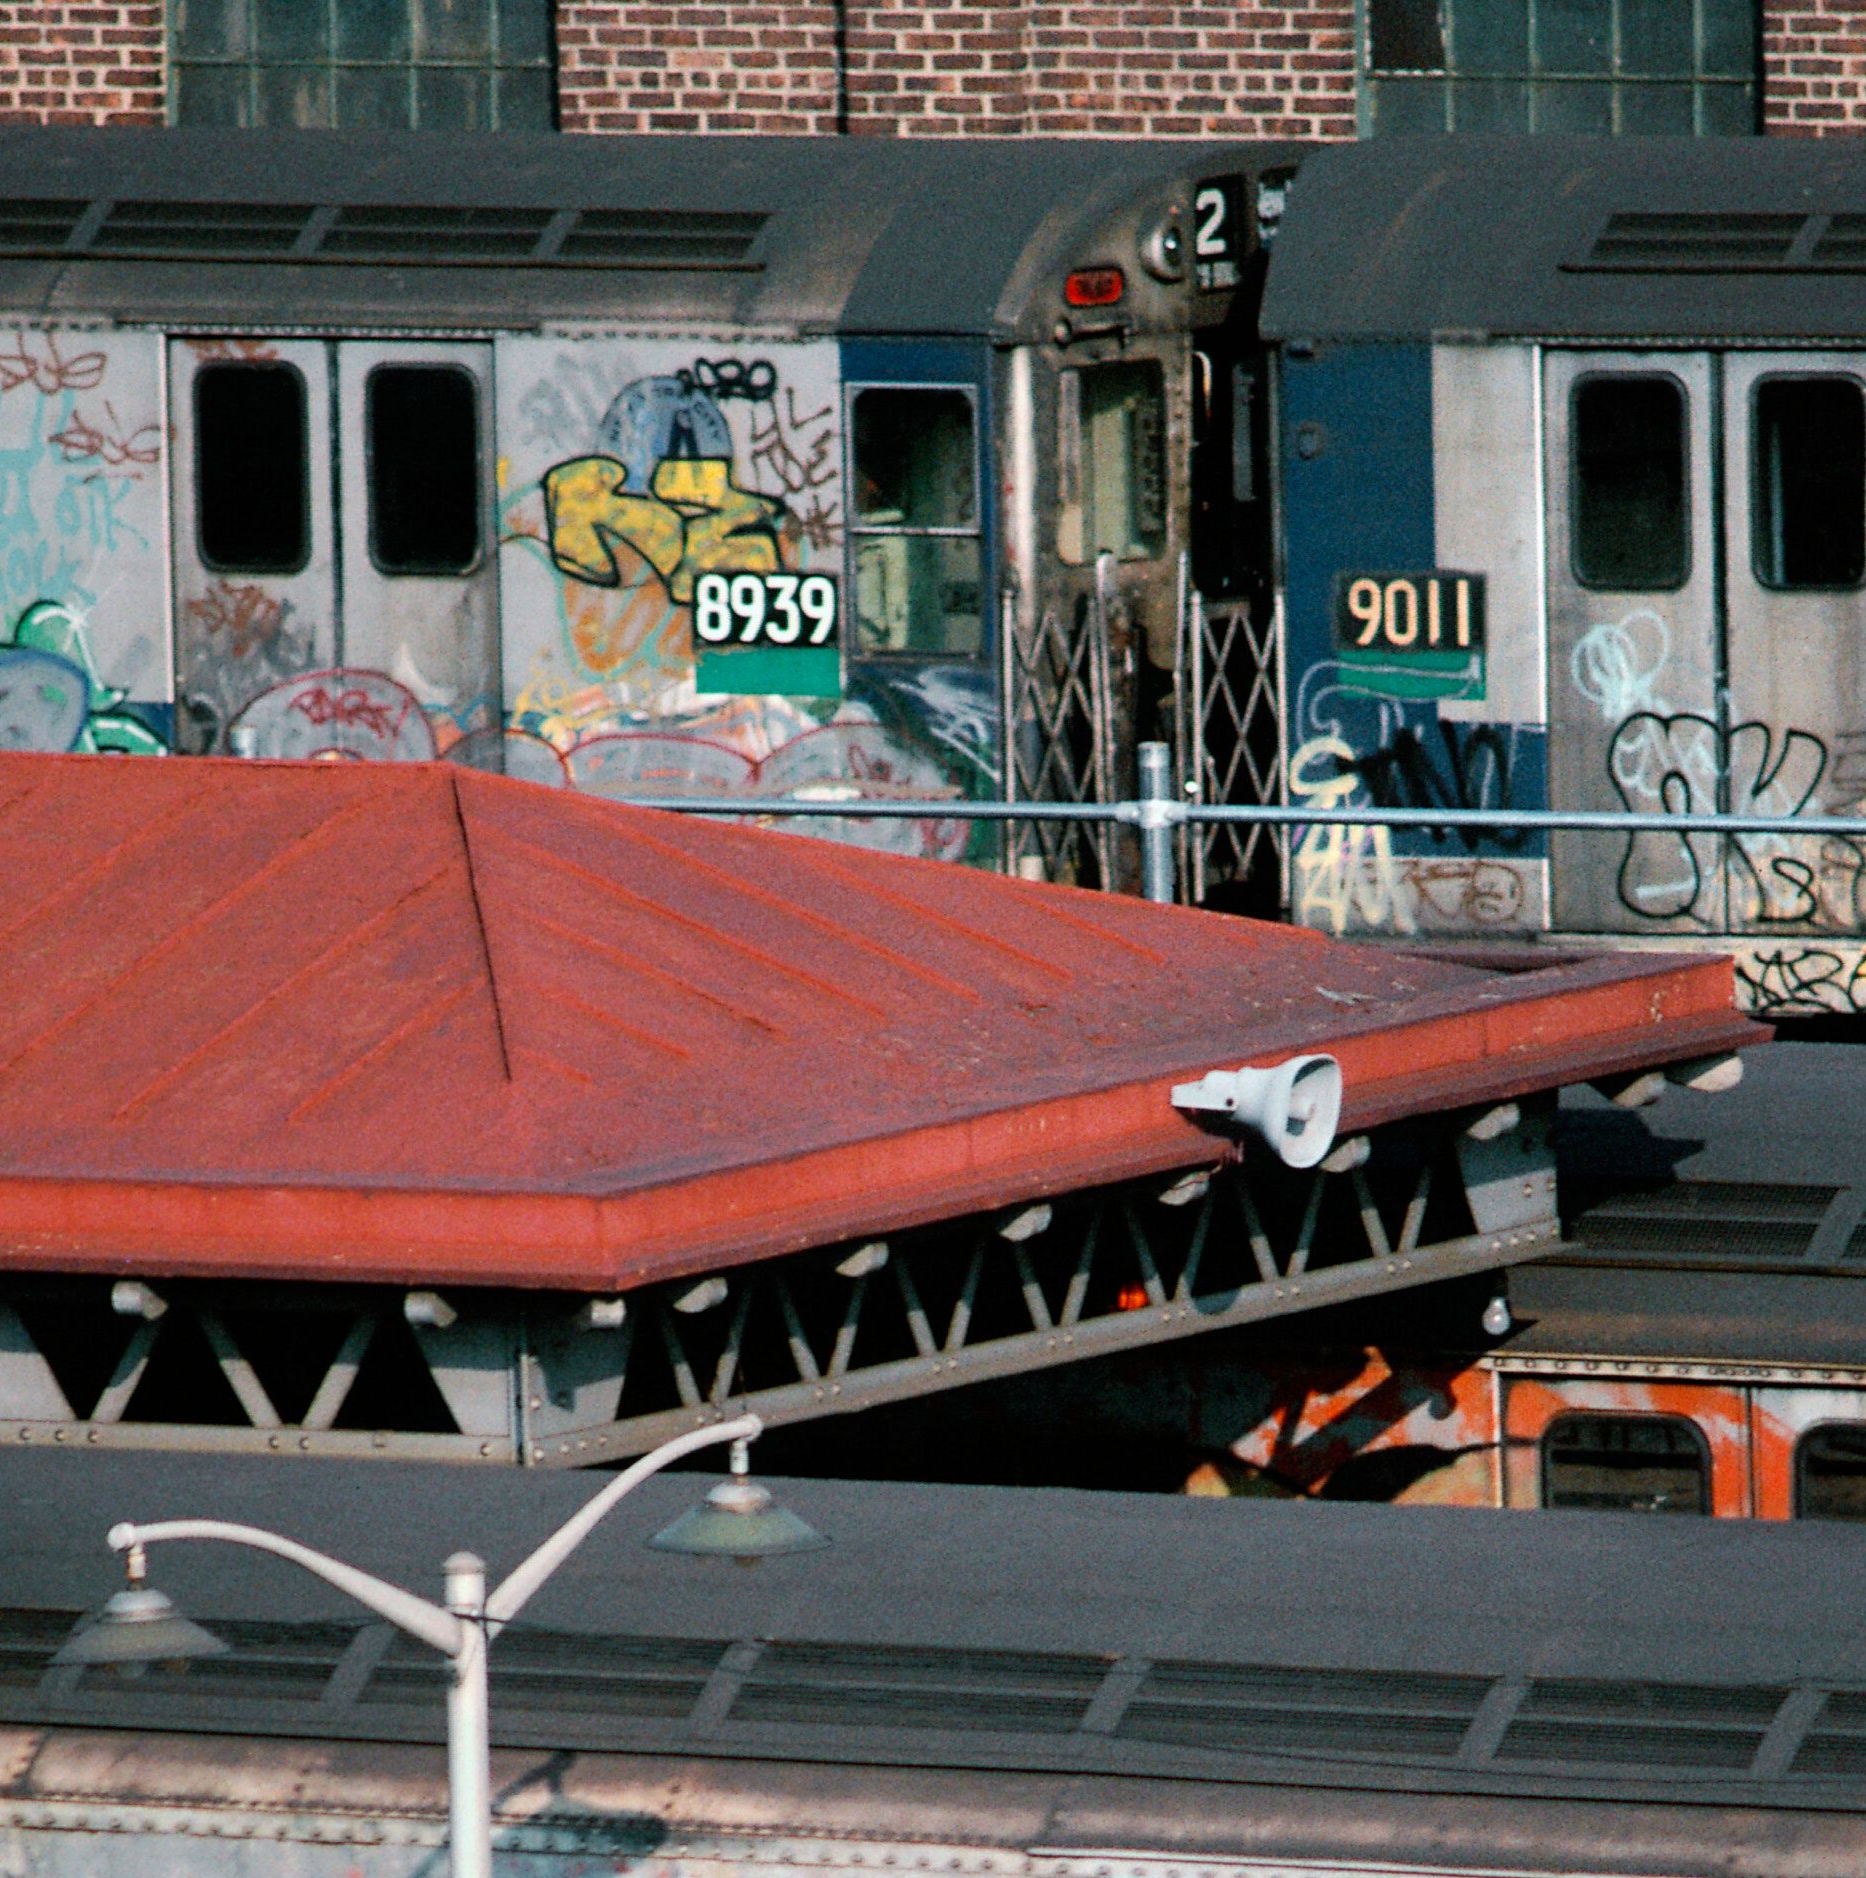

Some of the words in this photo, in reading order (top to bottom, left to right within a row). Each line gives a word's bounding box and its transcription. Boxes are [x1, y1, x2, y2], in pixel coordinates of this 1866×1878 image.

[1193, 186, 1227, 256] 2
[695, 574, 835, 644] 8939
[1348, 578, 1471, 647] 9011
